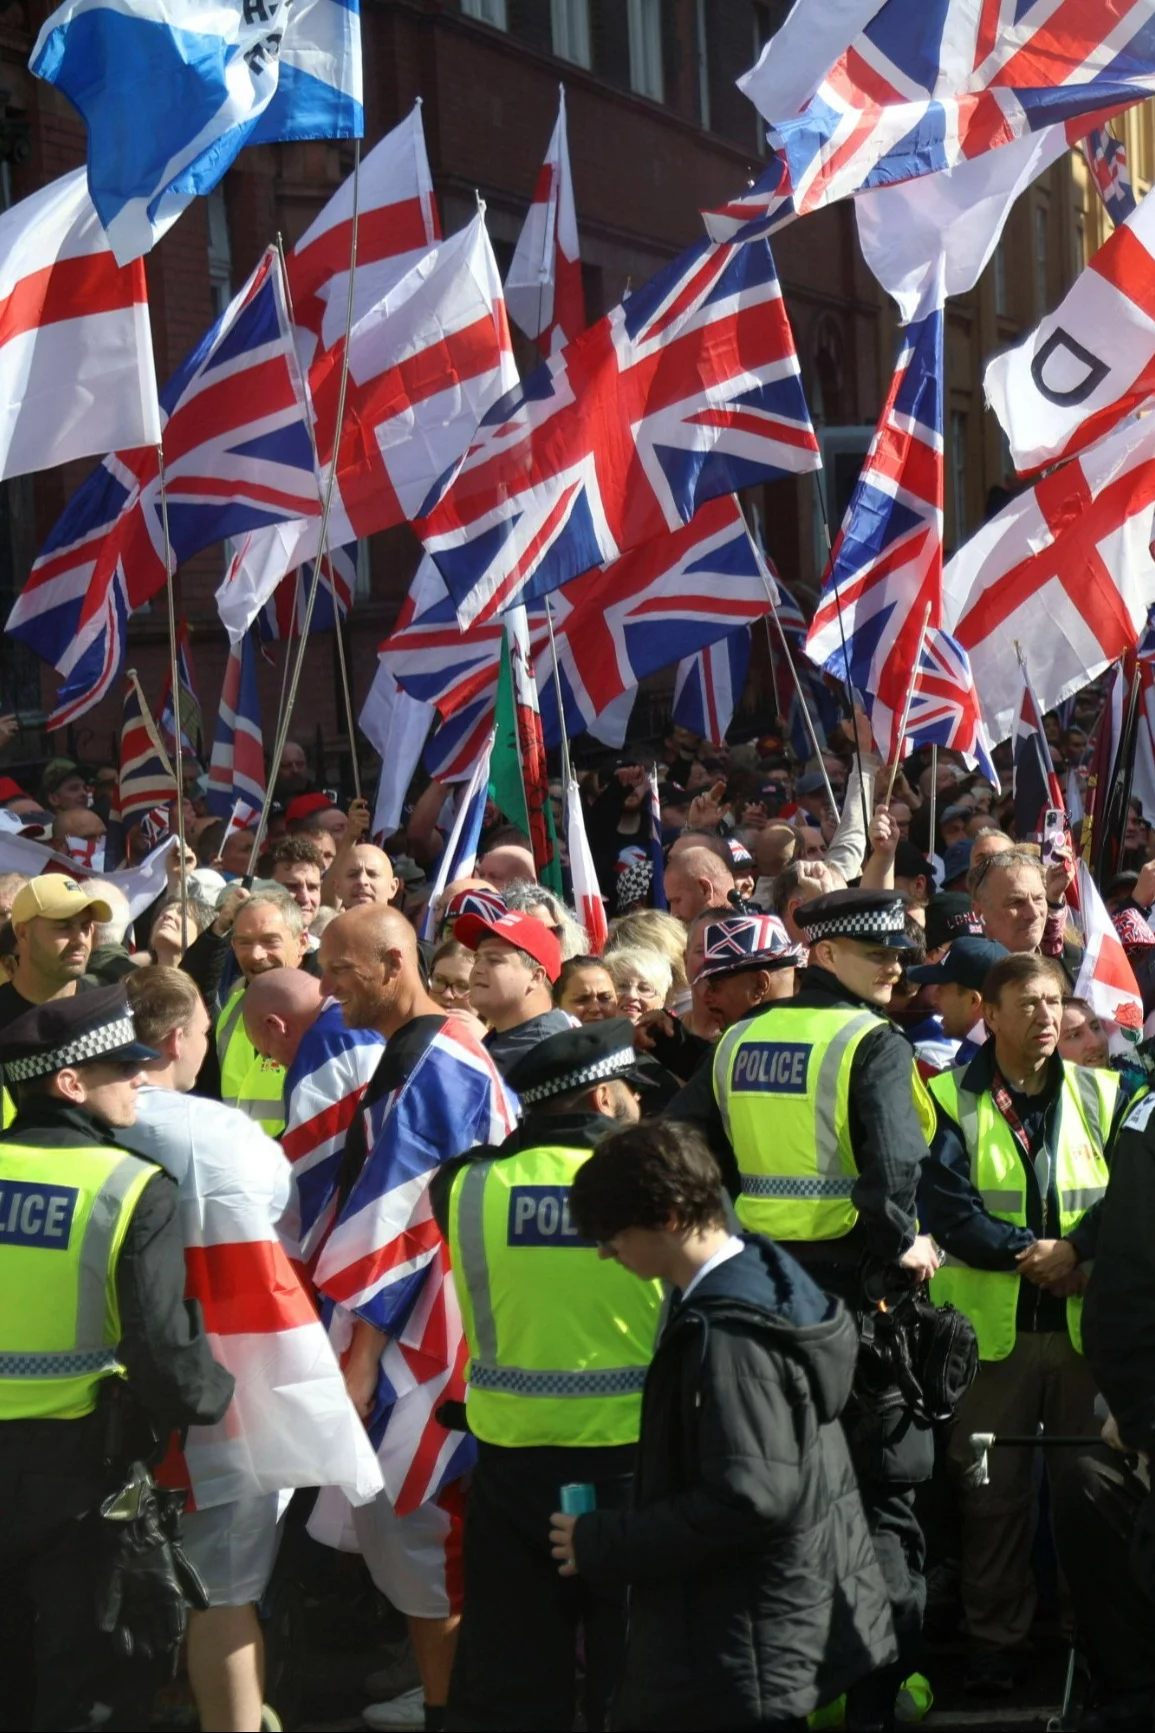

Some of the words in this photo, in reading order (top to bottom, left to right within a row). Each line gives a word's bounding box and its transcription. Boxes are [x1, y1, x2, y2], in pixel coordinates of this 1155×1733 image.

[734, 1049, 806, 1085] POLICE
[0, 1191, 69, 1237] ICE
[514, 1196, 579, 1236] POL
